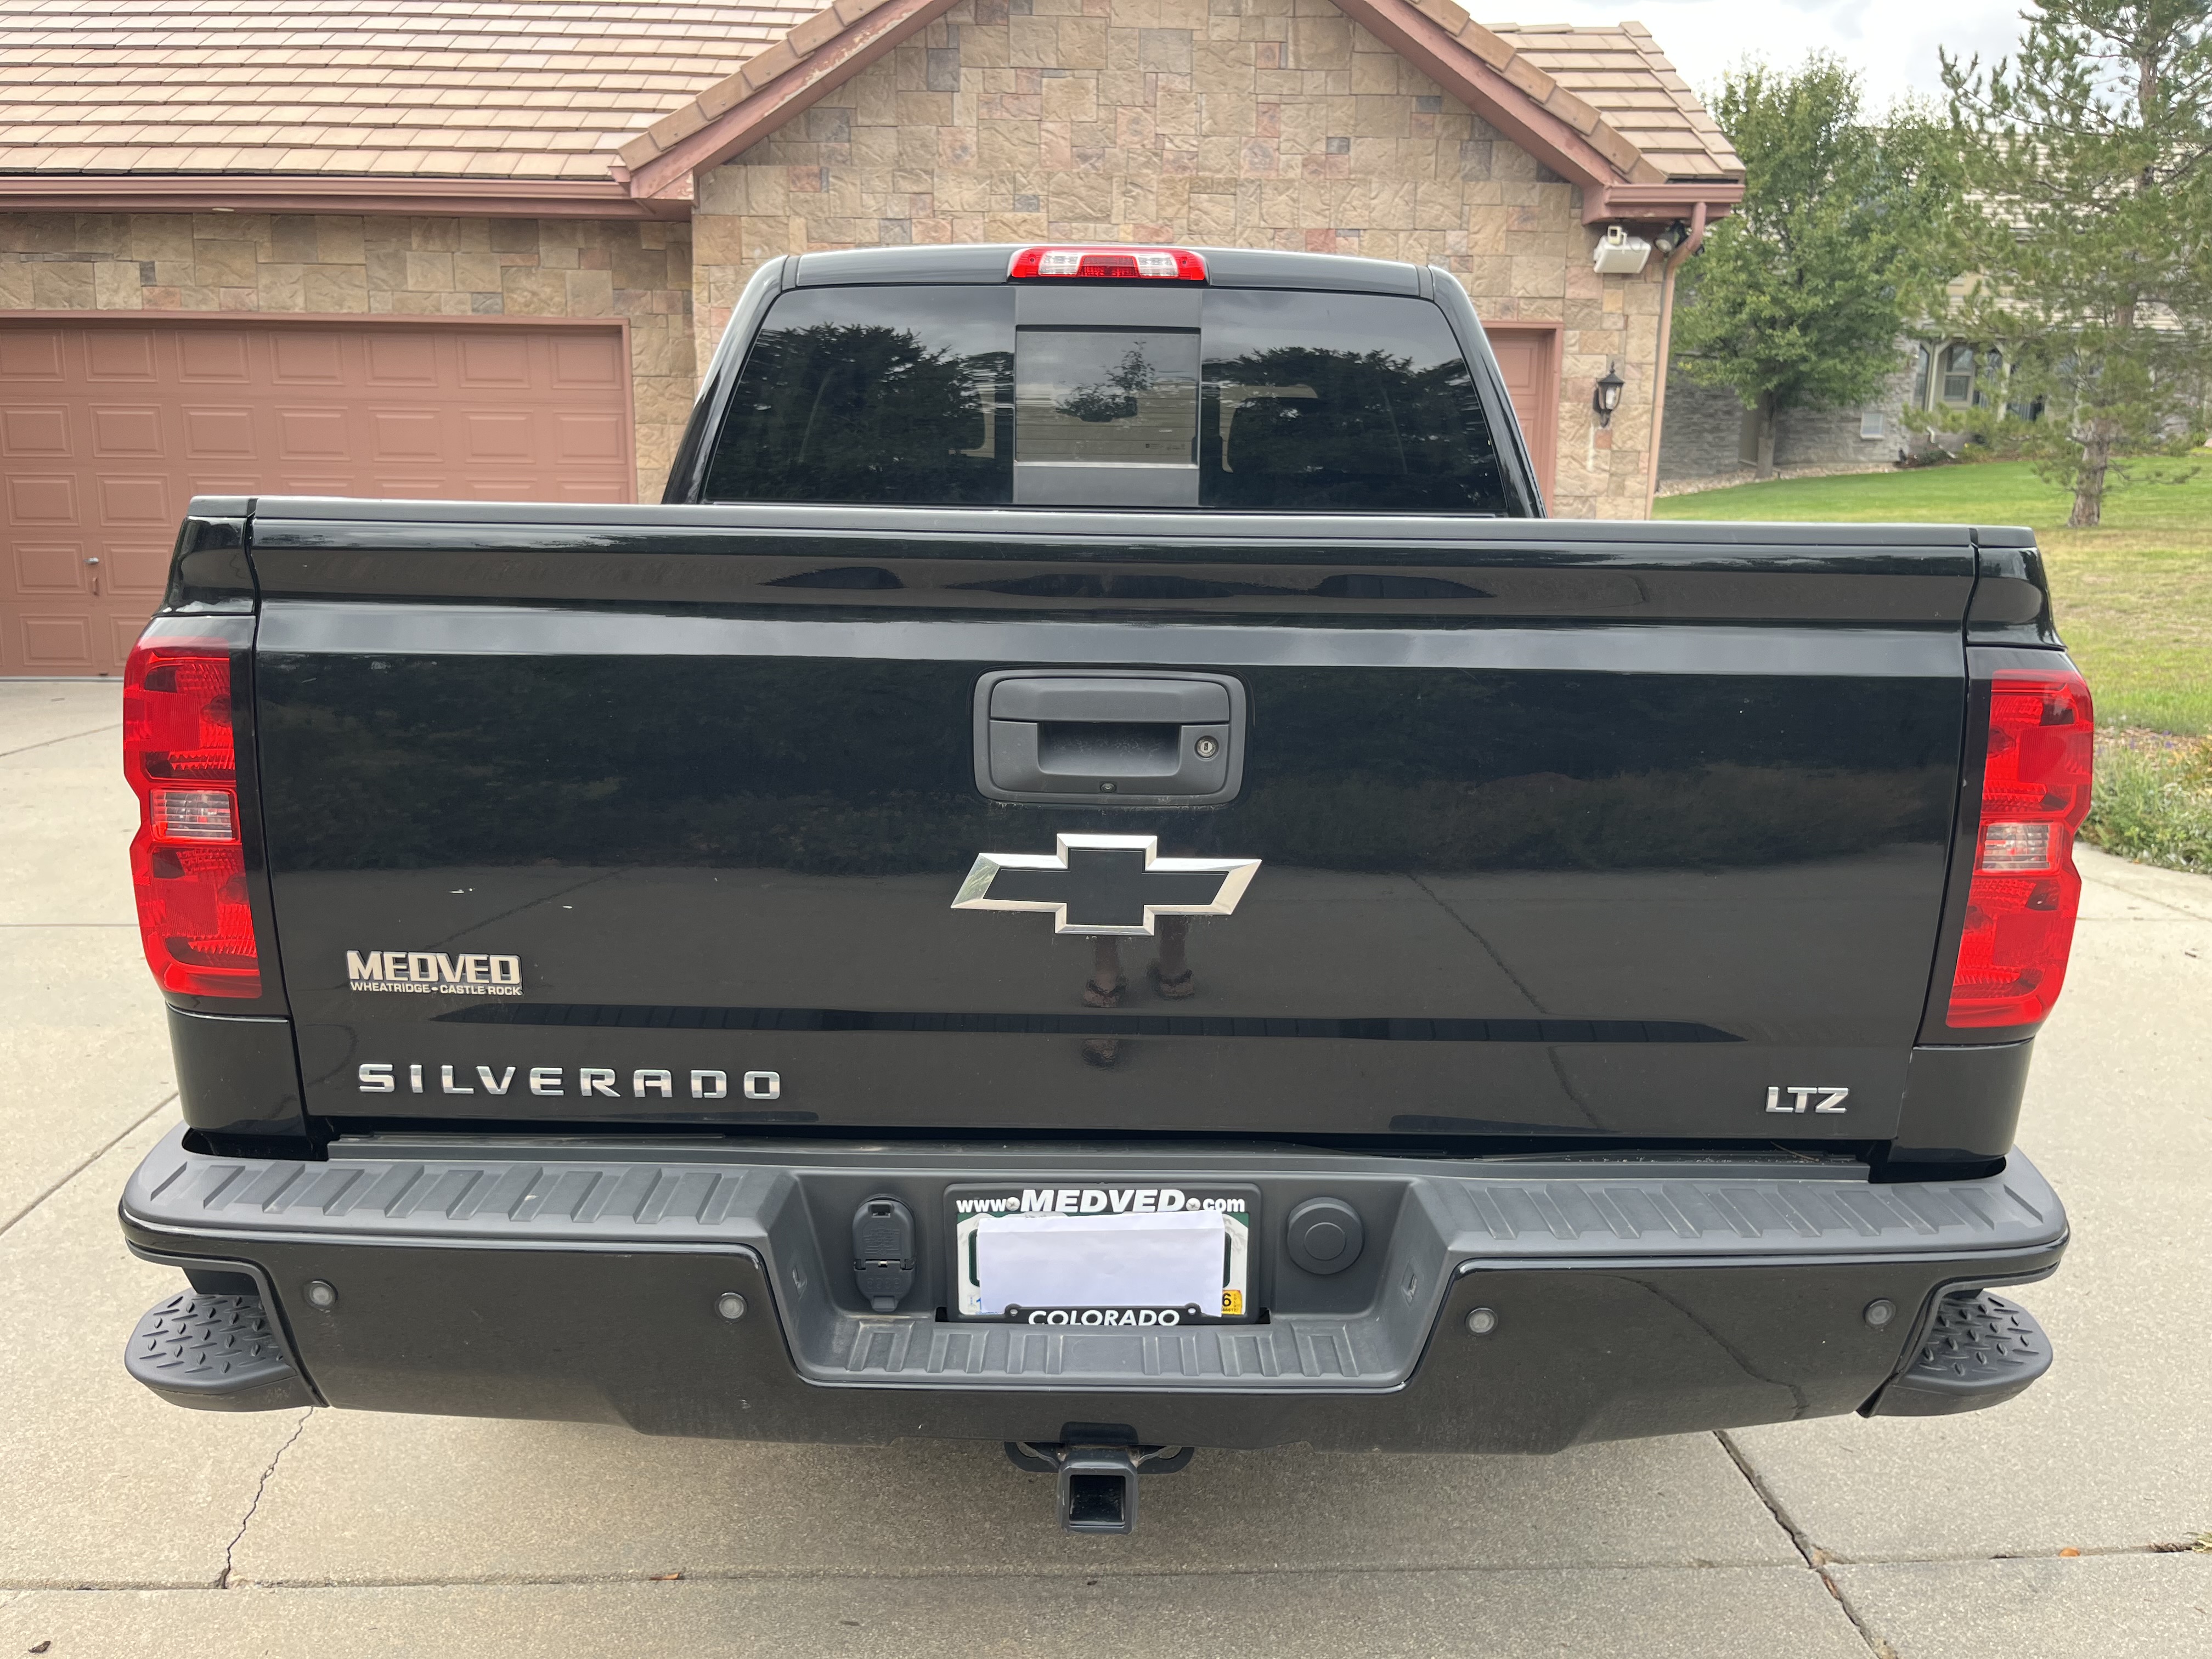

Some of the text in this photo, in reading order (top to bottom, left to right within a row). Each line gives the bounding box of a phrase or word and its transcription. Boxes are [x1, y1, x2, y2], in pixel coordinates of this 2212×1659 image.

[347, 950, 521, 984] MEDVED
[350, 981, 522, 995] WHEATRIDGE CASTLE ROCK
[359, 1063, 780, 1099] SILVERADO
[1765, 1086, 1849, 1113] LTZ
[1028, 1310, 1180, 1326] COLORADO
